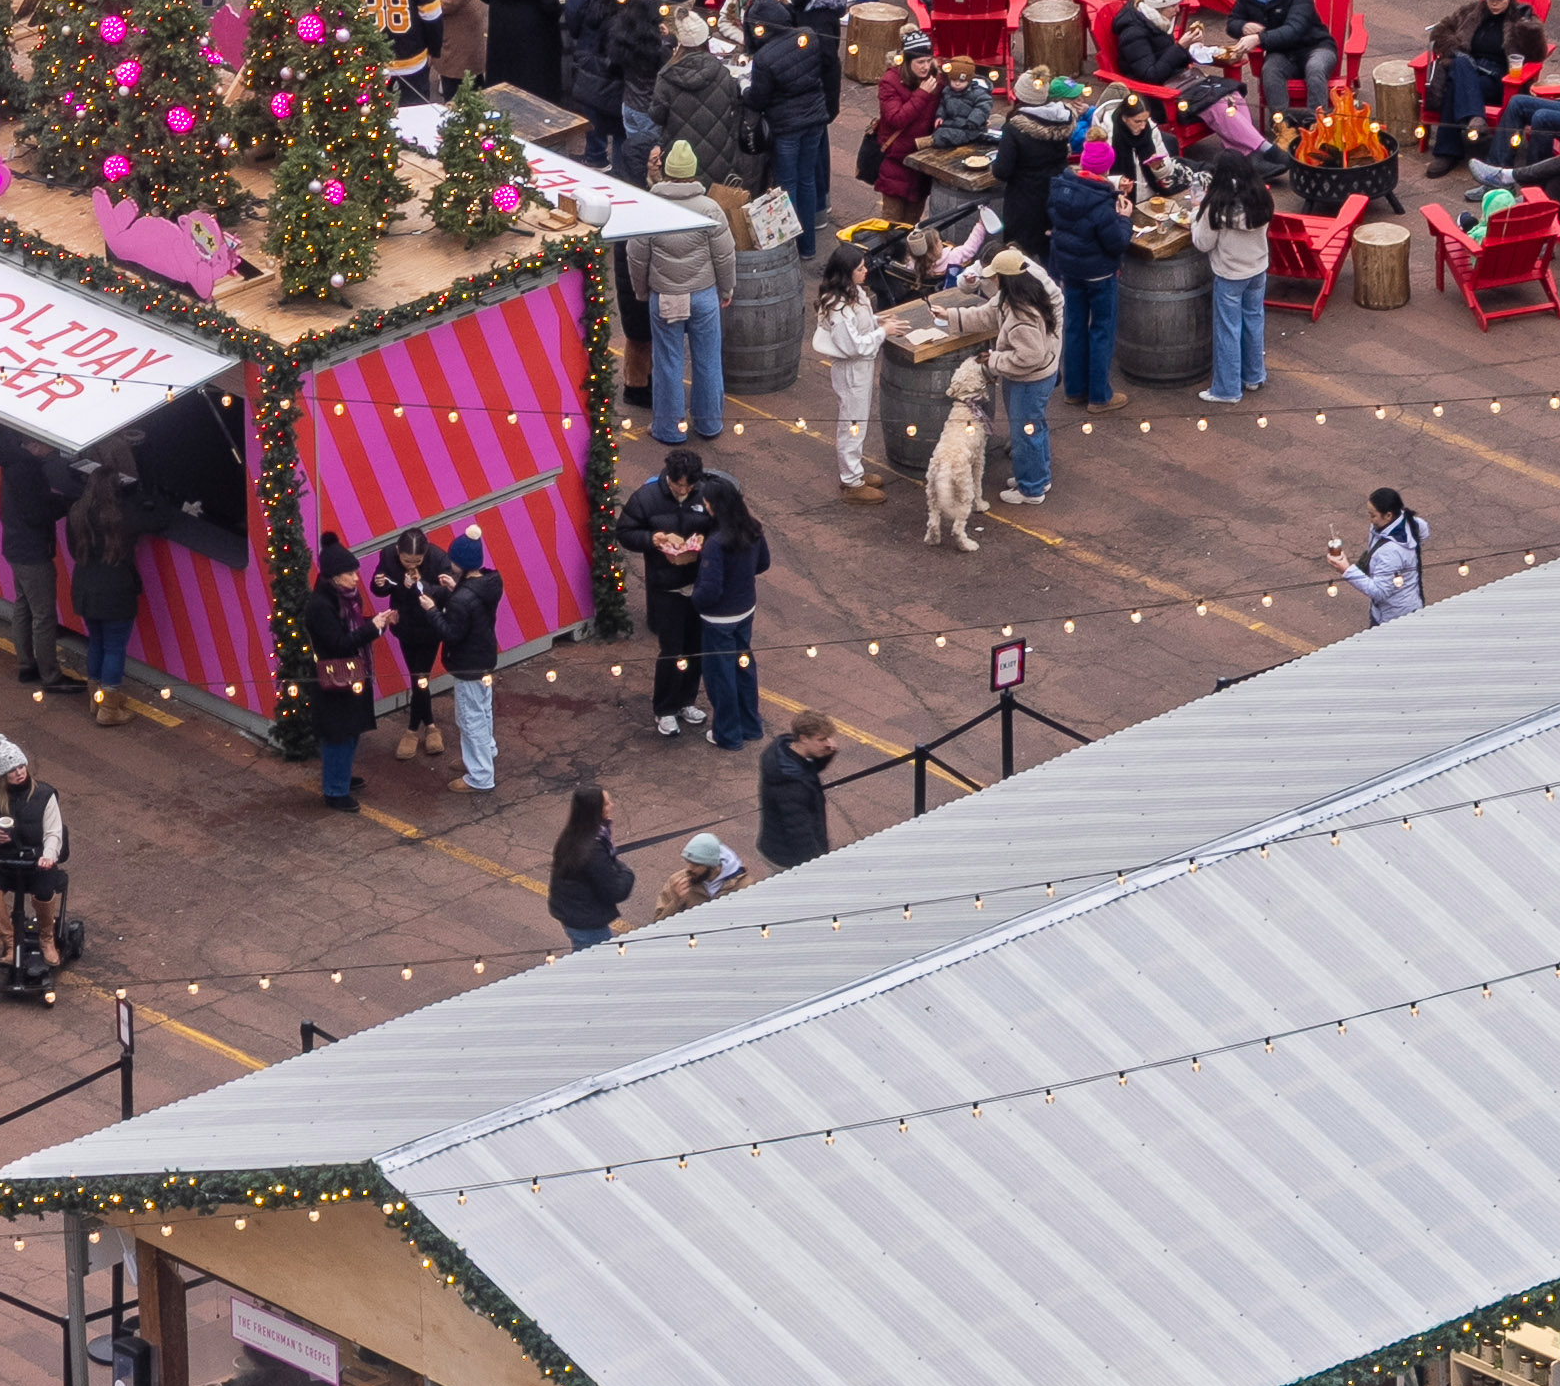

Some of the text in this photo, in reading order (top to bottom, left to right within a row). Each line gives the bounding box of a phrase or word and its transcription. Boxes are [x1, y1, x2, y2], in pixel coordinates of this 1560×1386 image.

[237, 1314, 333, 1368] THE FRENCHMAN'S CREPES
